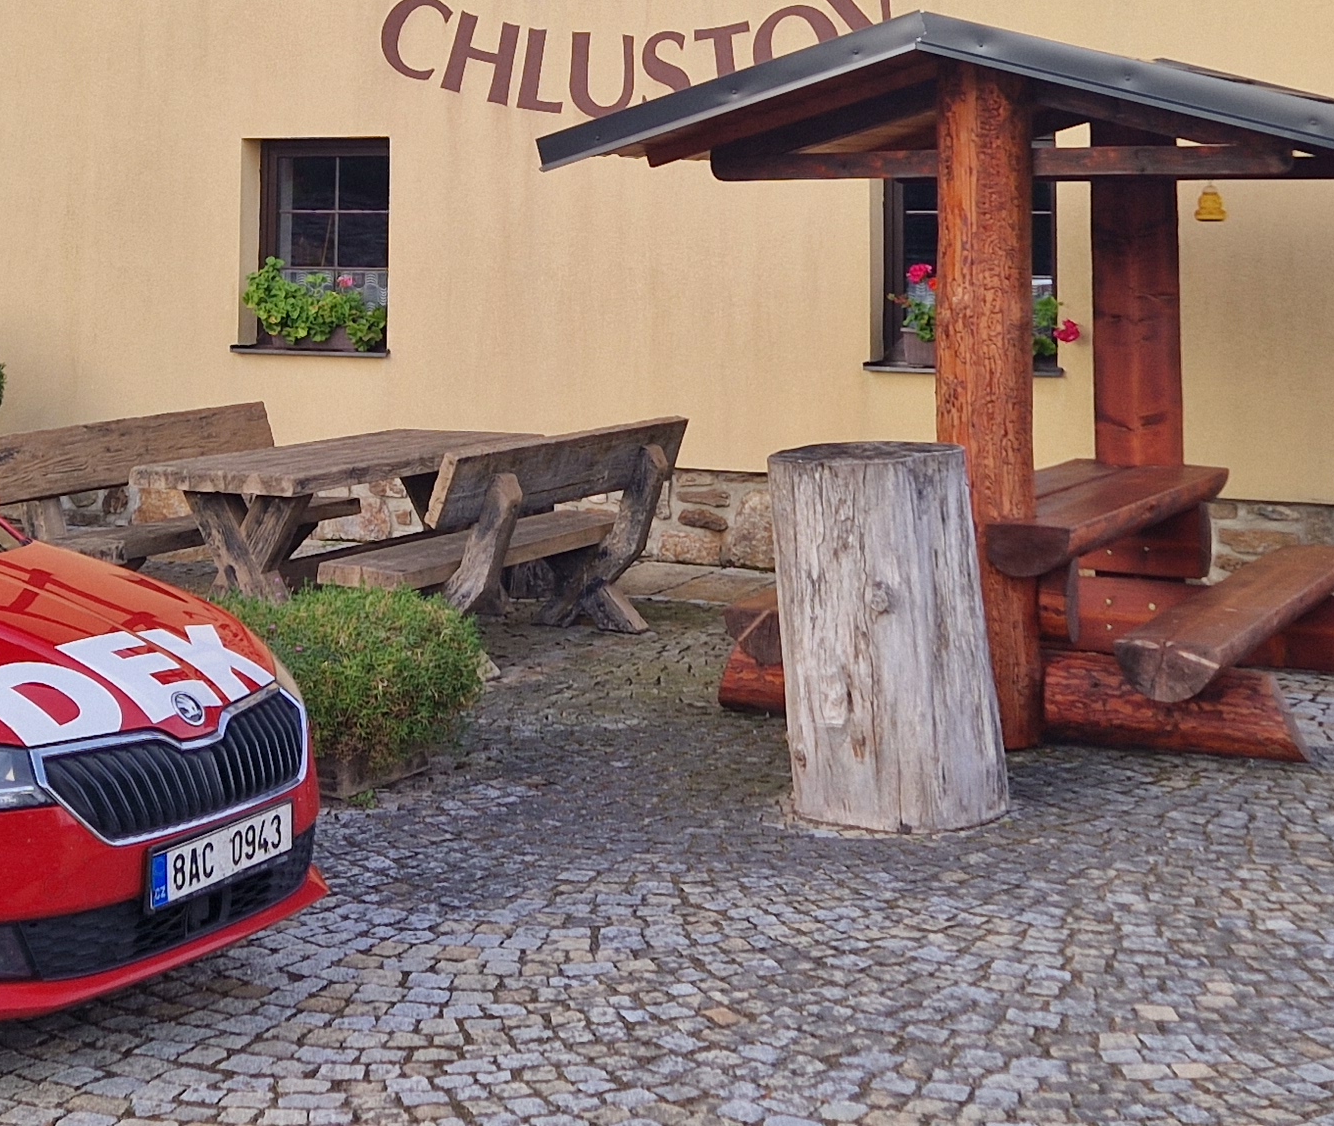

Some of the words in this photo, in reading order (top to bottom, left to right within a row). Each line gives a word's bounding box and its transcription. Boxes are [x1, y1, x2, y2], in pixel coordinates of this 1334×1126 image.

[173, 842, 214, 890] 8AC
[231, 814, 282, 866] 0943
[154, 885, 166, 900] CZ
